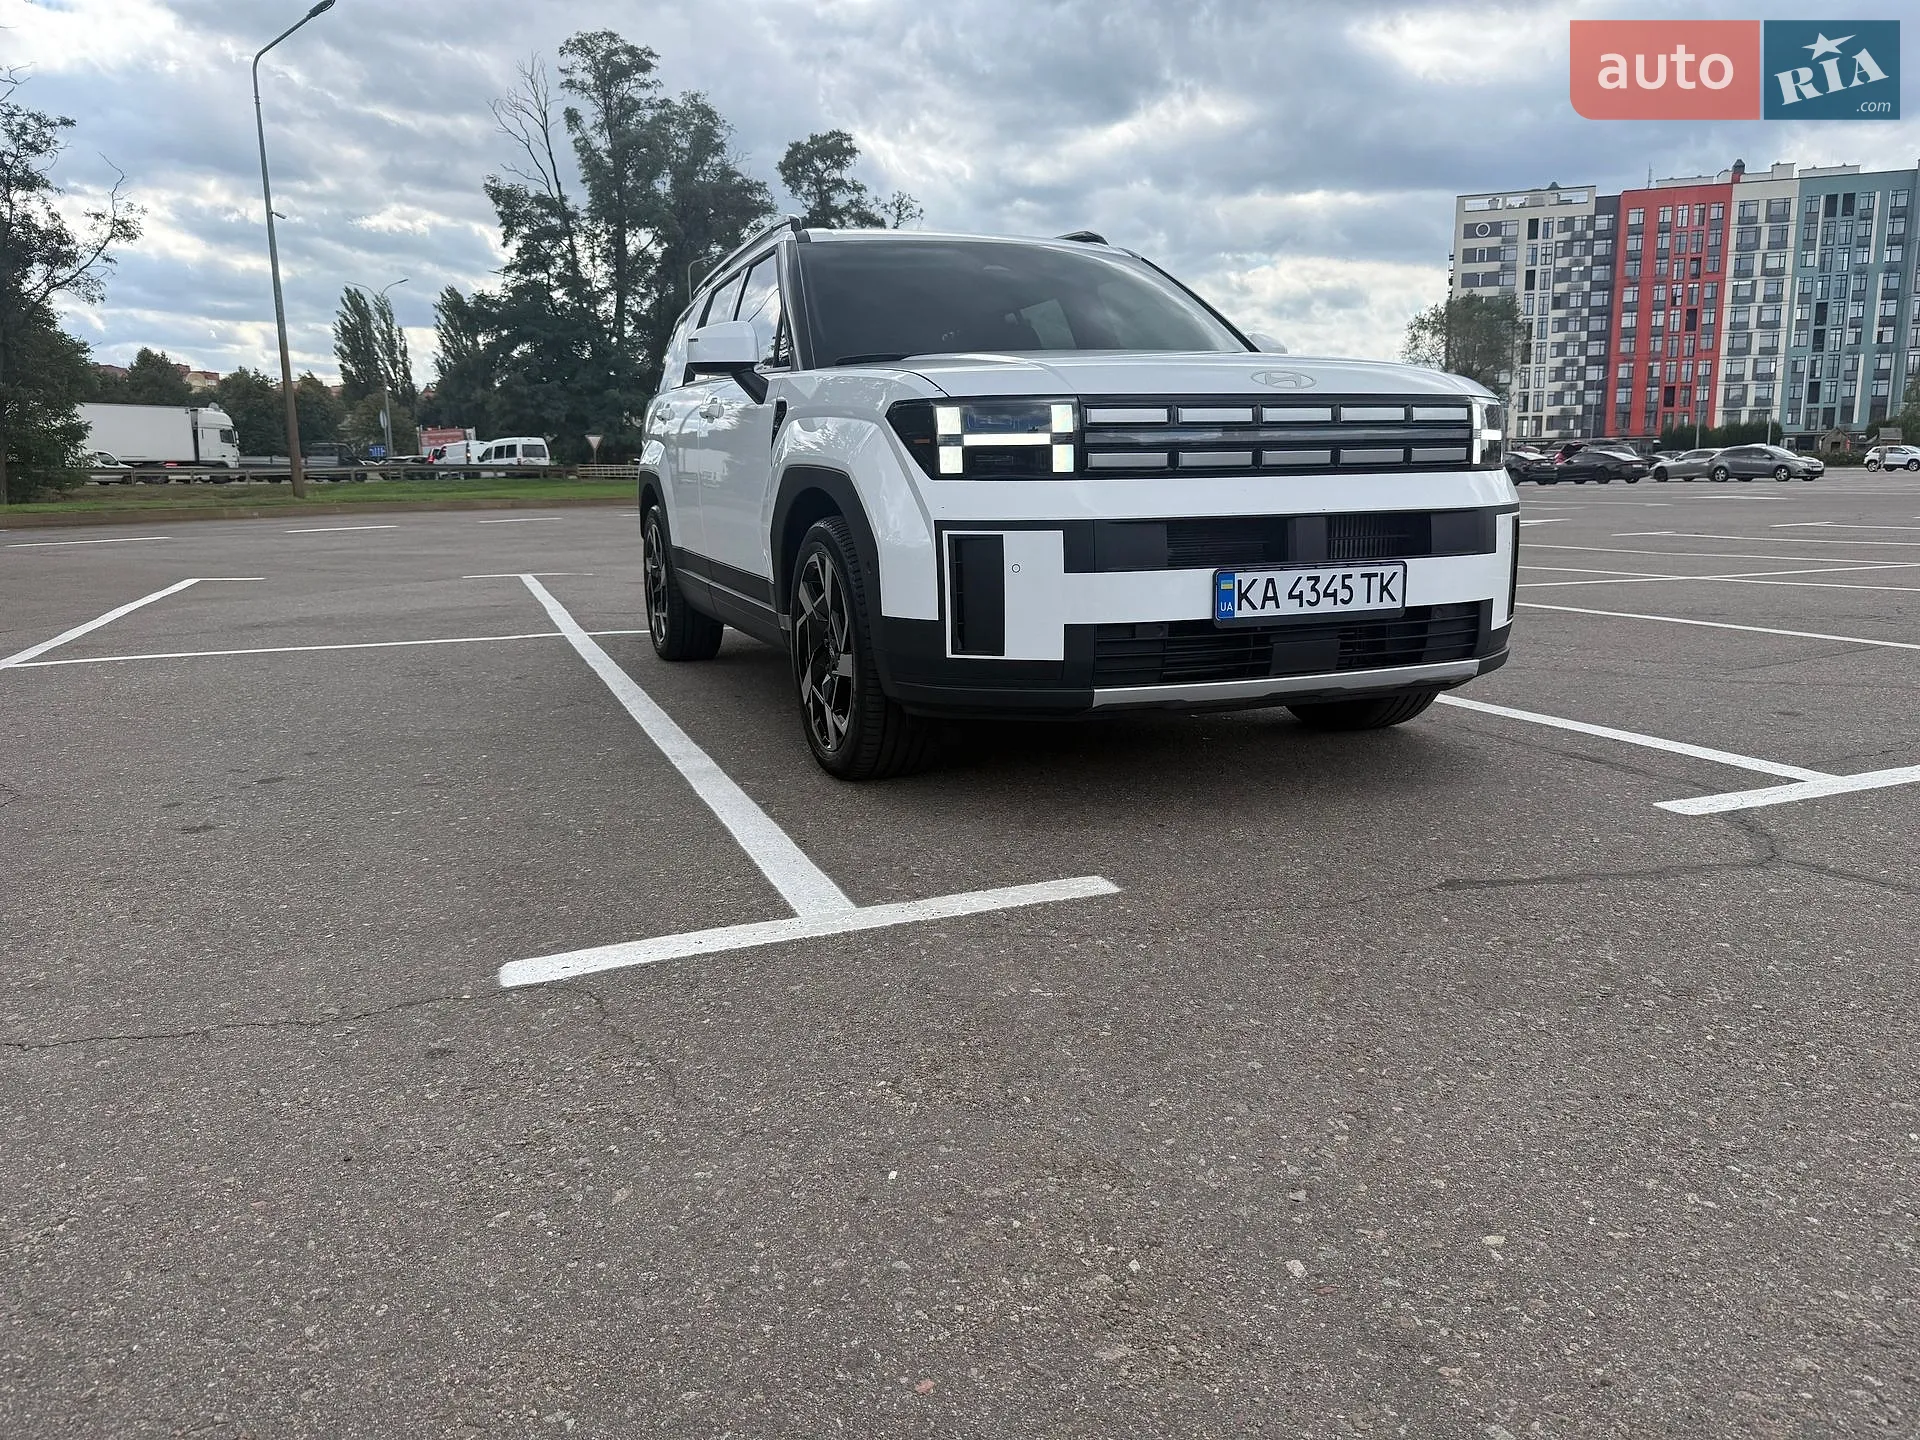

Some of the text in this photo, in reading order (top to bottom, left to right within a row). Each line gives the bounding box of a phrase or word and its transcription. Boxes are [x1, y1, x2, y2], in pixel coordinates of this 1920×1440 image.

[1236, 571, 1398, 611] KA 4345 TK
[1220, 601, 1234, 612] UA
